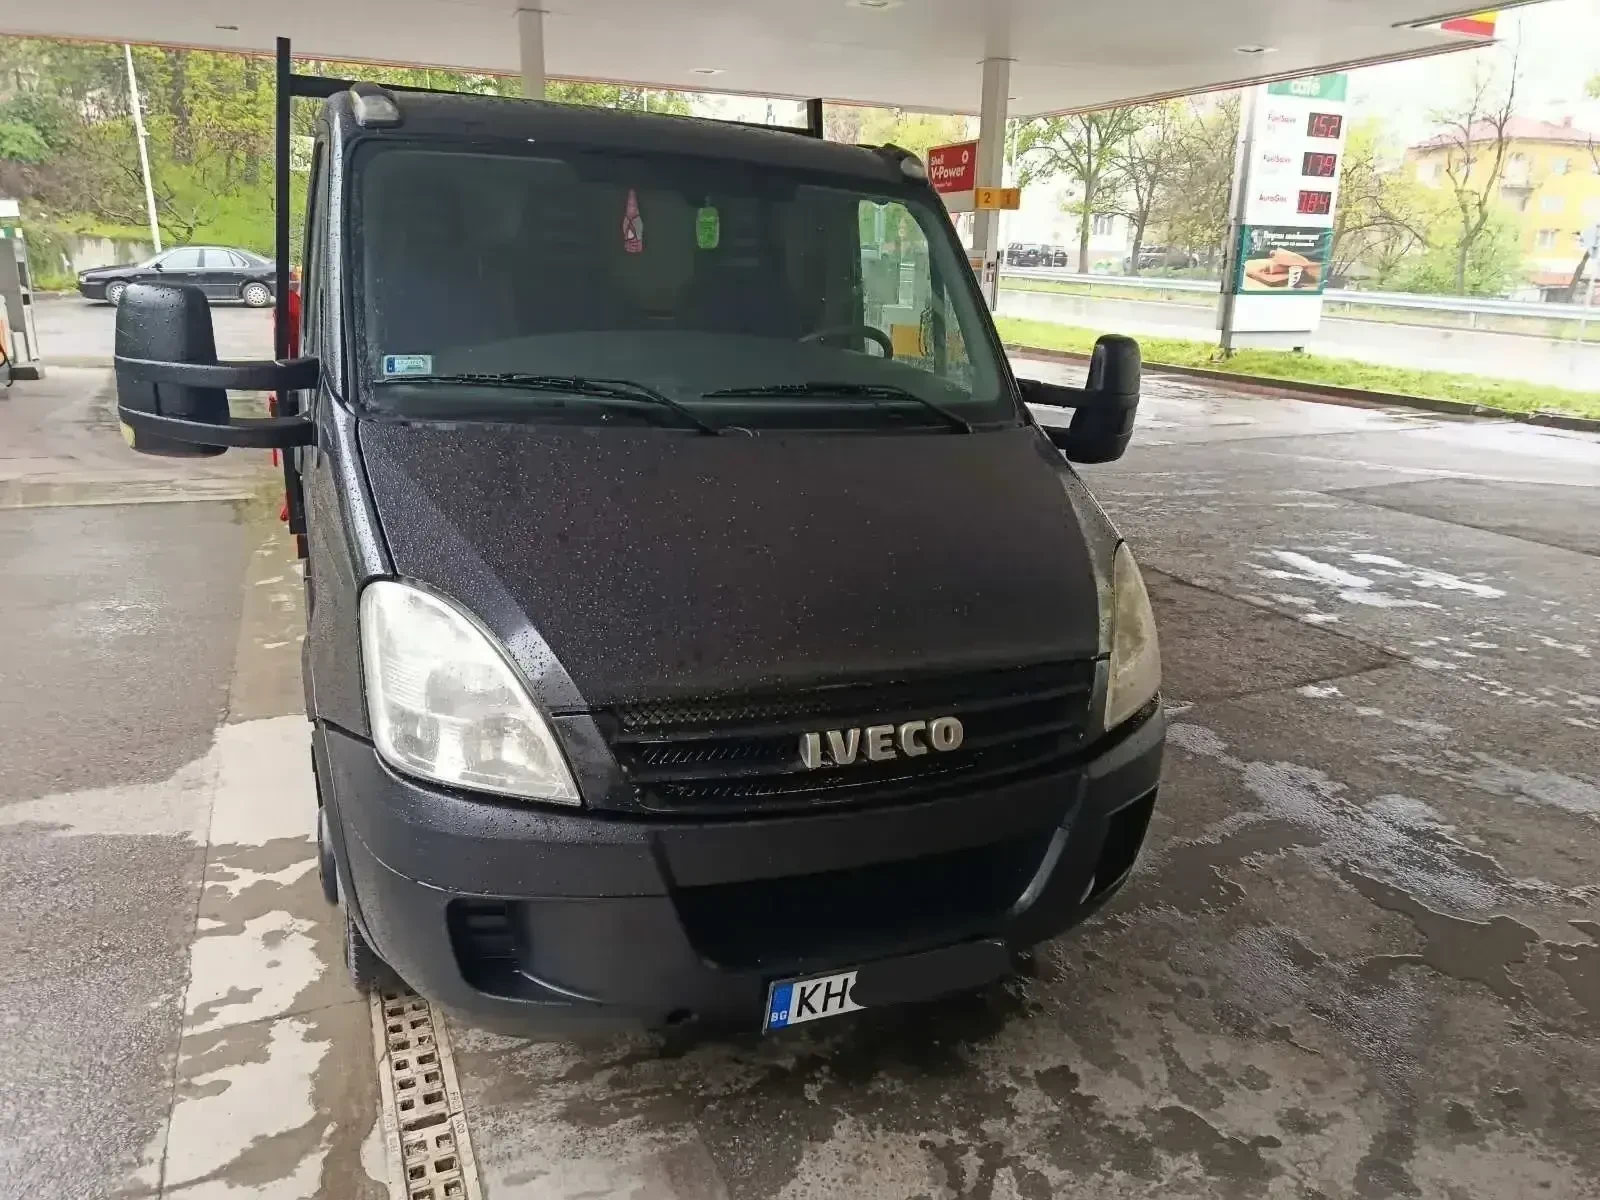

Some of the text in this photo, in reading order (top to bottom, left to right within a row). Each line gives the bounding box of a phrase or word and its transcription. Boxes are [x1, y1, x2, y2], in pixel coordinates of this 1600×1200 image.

[931, 154, 944, 166] Shell
[931, 166, 966, 179] V-Power
[983, 191, 991, 203] 2
[801, 716, 964, 769] IVECO
[796, 977, 849, 1018] KH
[770, 1010, 788, 1023] BG
